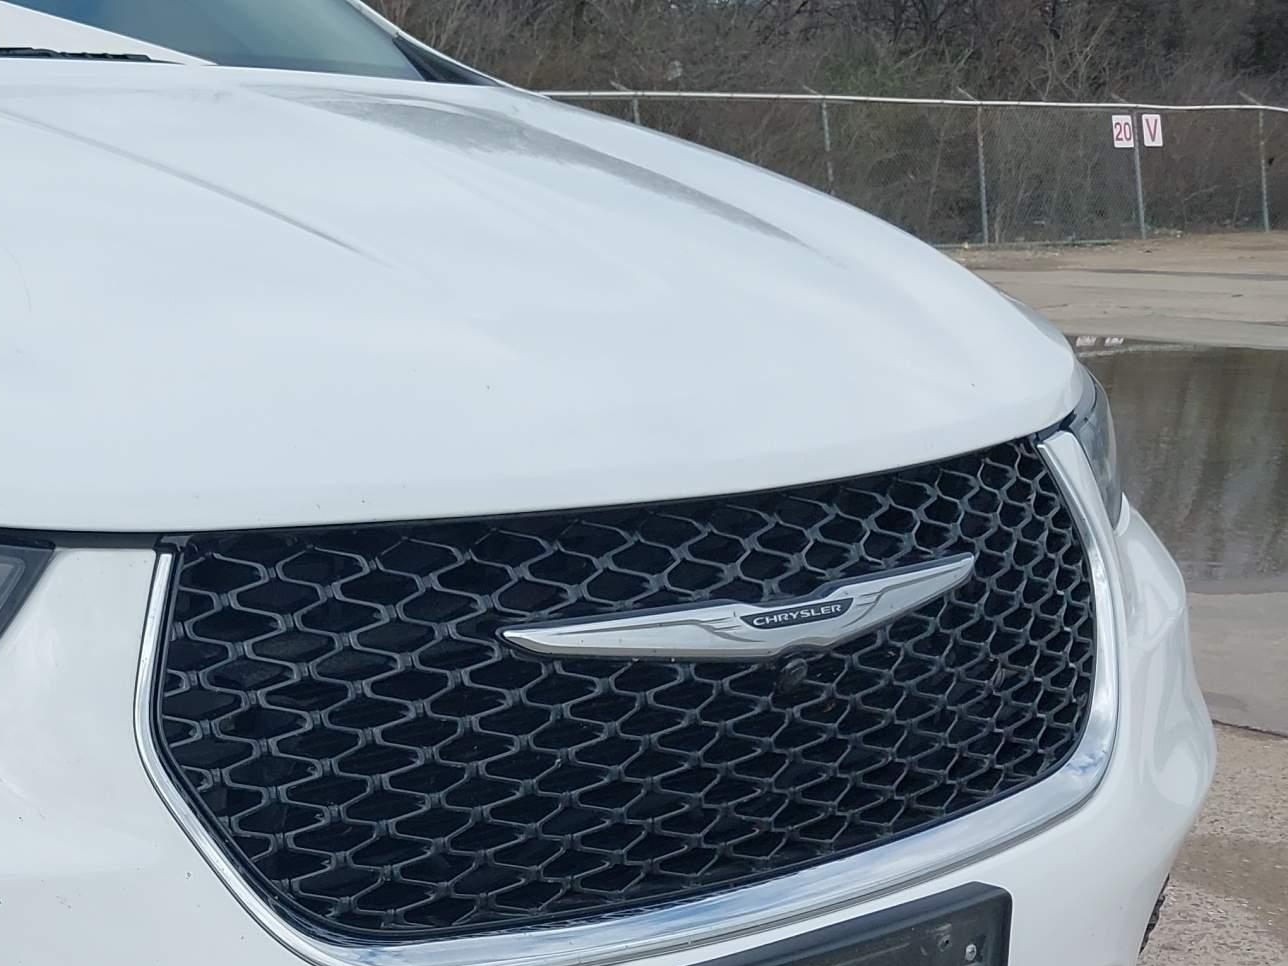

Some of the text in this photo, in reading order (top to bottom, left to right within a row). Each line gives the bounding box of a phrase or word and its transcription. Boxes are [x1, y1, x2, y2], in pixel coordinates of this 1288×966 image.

[1114, 122, 1132, 142] 20
[1145, 118, 1158, 142] V
[752, 603, 843, 627] CHRYSLER
